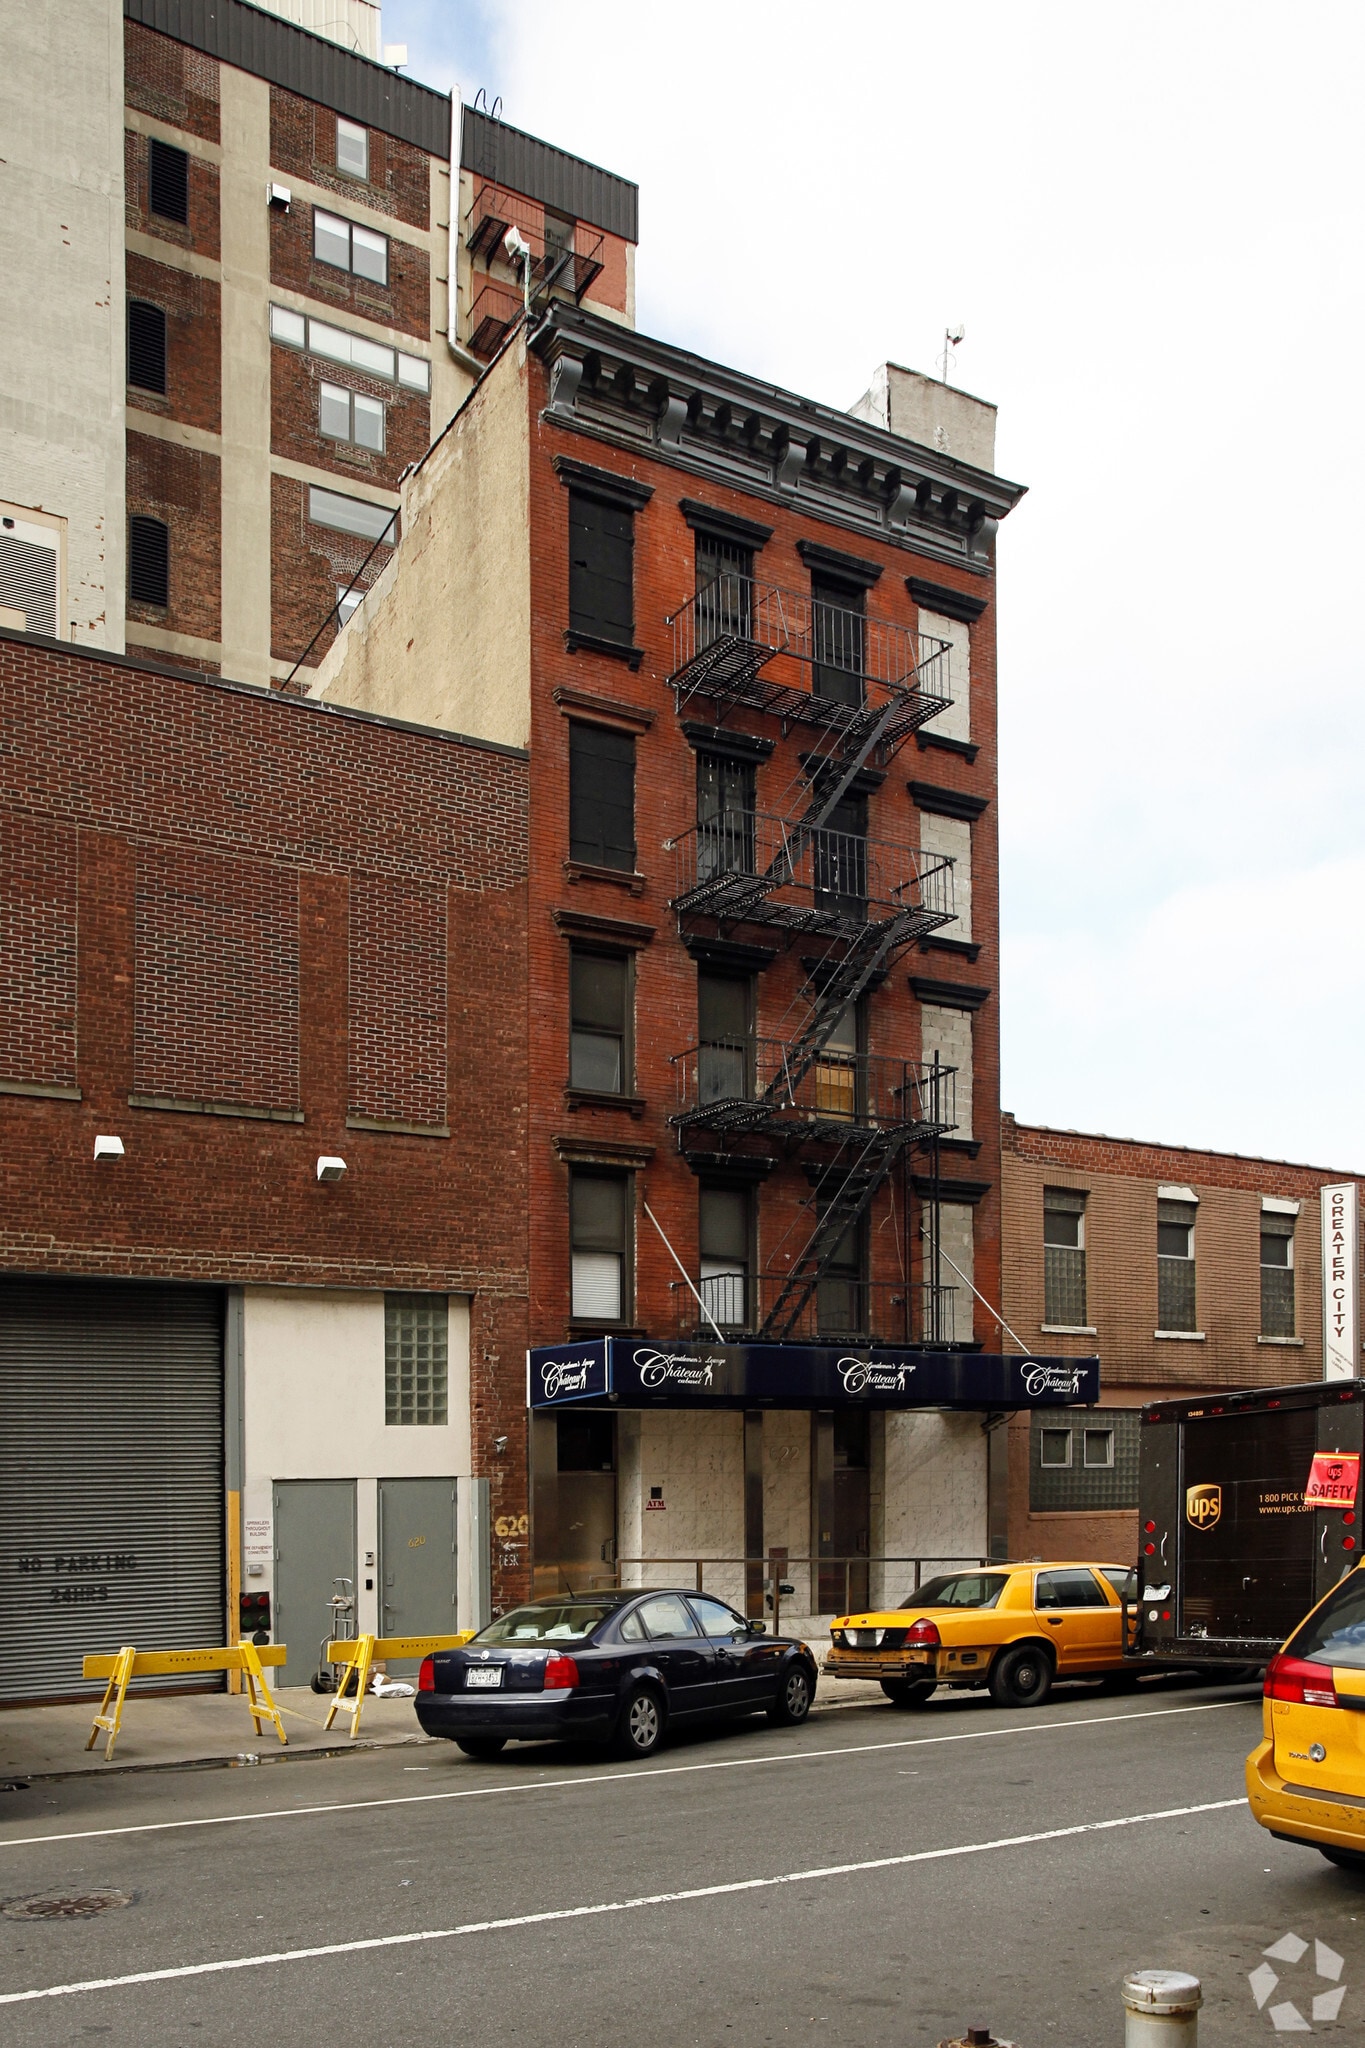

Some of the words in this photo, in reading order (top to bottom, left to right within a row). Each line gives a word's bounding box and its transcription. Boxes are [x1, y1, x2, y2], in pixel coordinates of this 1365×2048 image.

[1331, 1193, 1345, 1281] GREATER
[1332, 1288, 1345, 1337] CITY
[633, 1348, 703, 1387] Château
[837, 1357, 897, 1393] Château
[1020, 1362, 1072, 1396] Château
[1328, 1467, 1343, 1479] ups
[1264, 1493, 1280, 1503] 800
[1281, 1492, 1299, 1502] PICK
[1311, 1483, 1354, 1499] SAFETY
[1189, 1497, 1219, 1524] ups
[1258, 1505, 1315, 1515] www.ups.com
[494, 1514, 529, 1537] 620
[408, 1535, 426, 1548] 620
[19, 1557, 41, 1573] NO
[55, 1554, 137, 1573] PARKING
